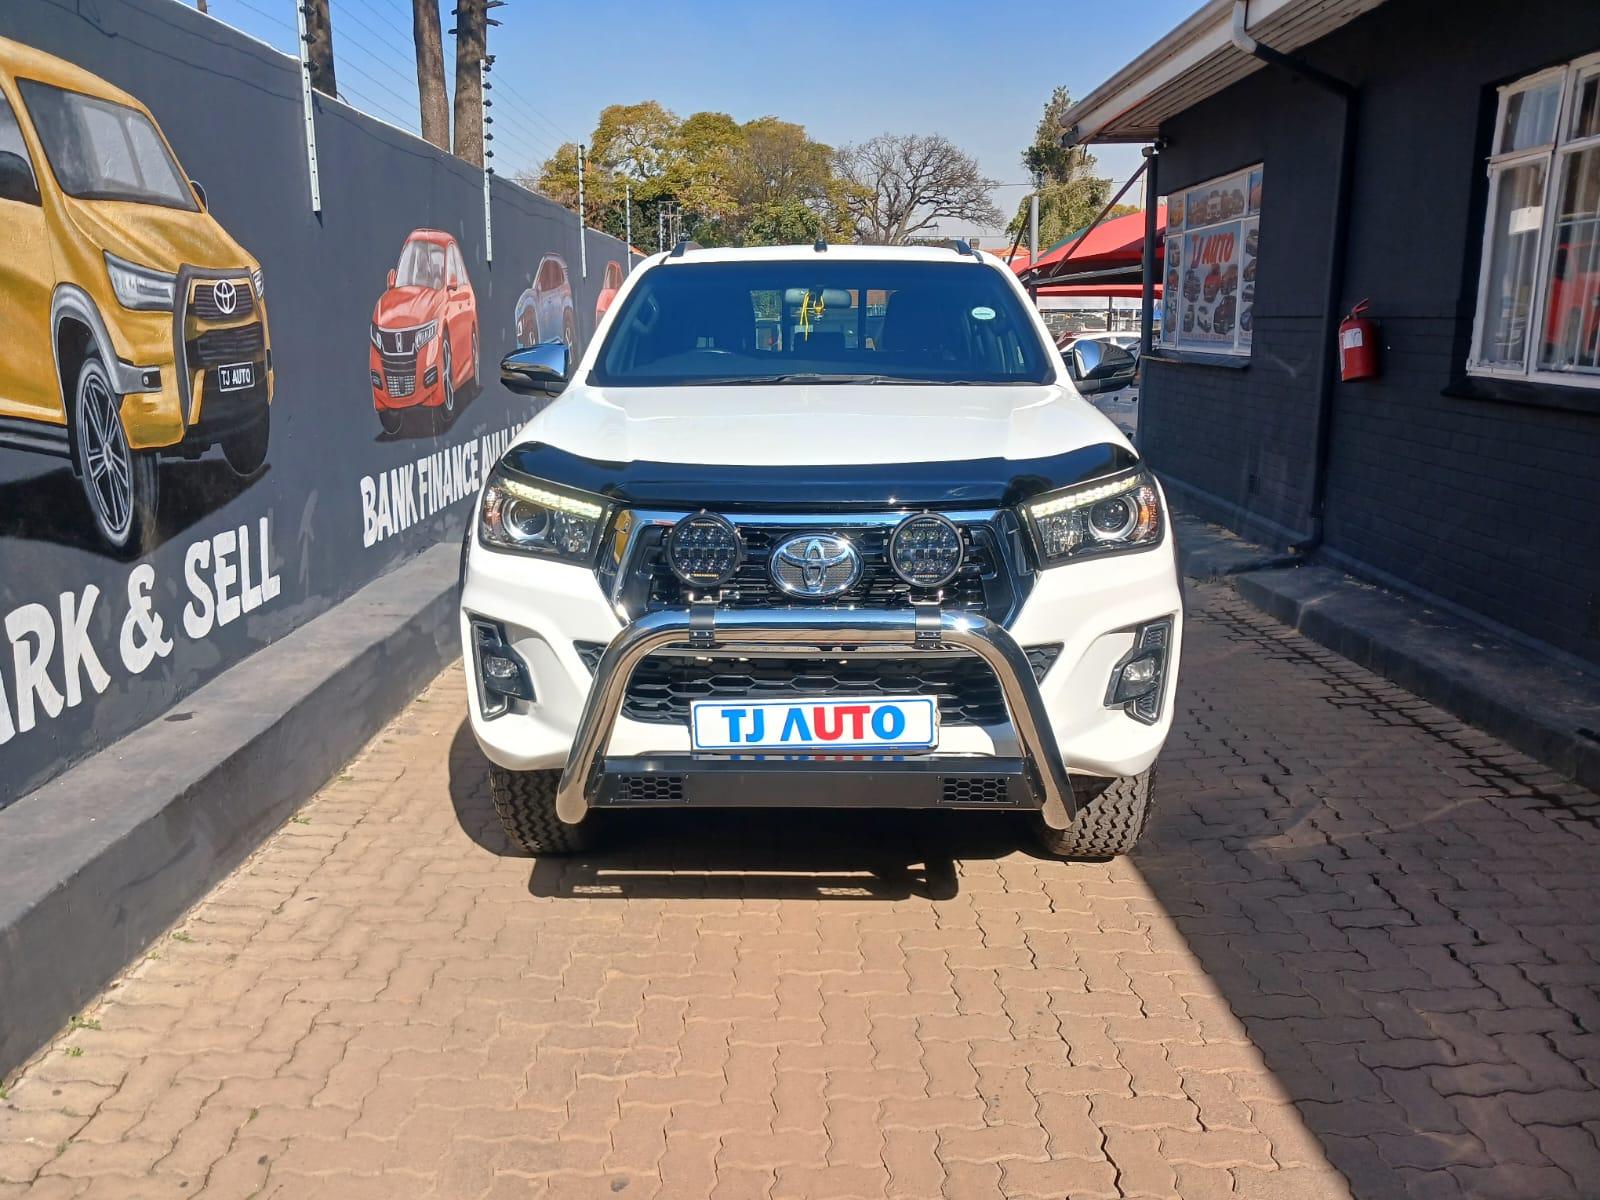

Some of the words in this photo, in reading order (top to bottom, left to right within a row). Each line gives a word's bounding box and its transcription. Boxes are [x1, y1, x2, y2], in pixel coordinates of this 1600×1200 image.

[1202, 232, 1234, 264] AUTO
[221, 370, 230, 386] TJ
[232, 368, 251, 385] AUTO
[360, 462, 418, 548] BANK
[417, 439, 480, 520] FINANCE
[0, 584, 111, 745] RK
[120, 563, 174, 674] &
[183, 516, 281, 640] SELL
[721, 708, 765, 742] TJ
[780, 705, 906, 741] AUTO
